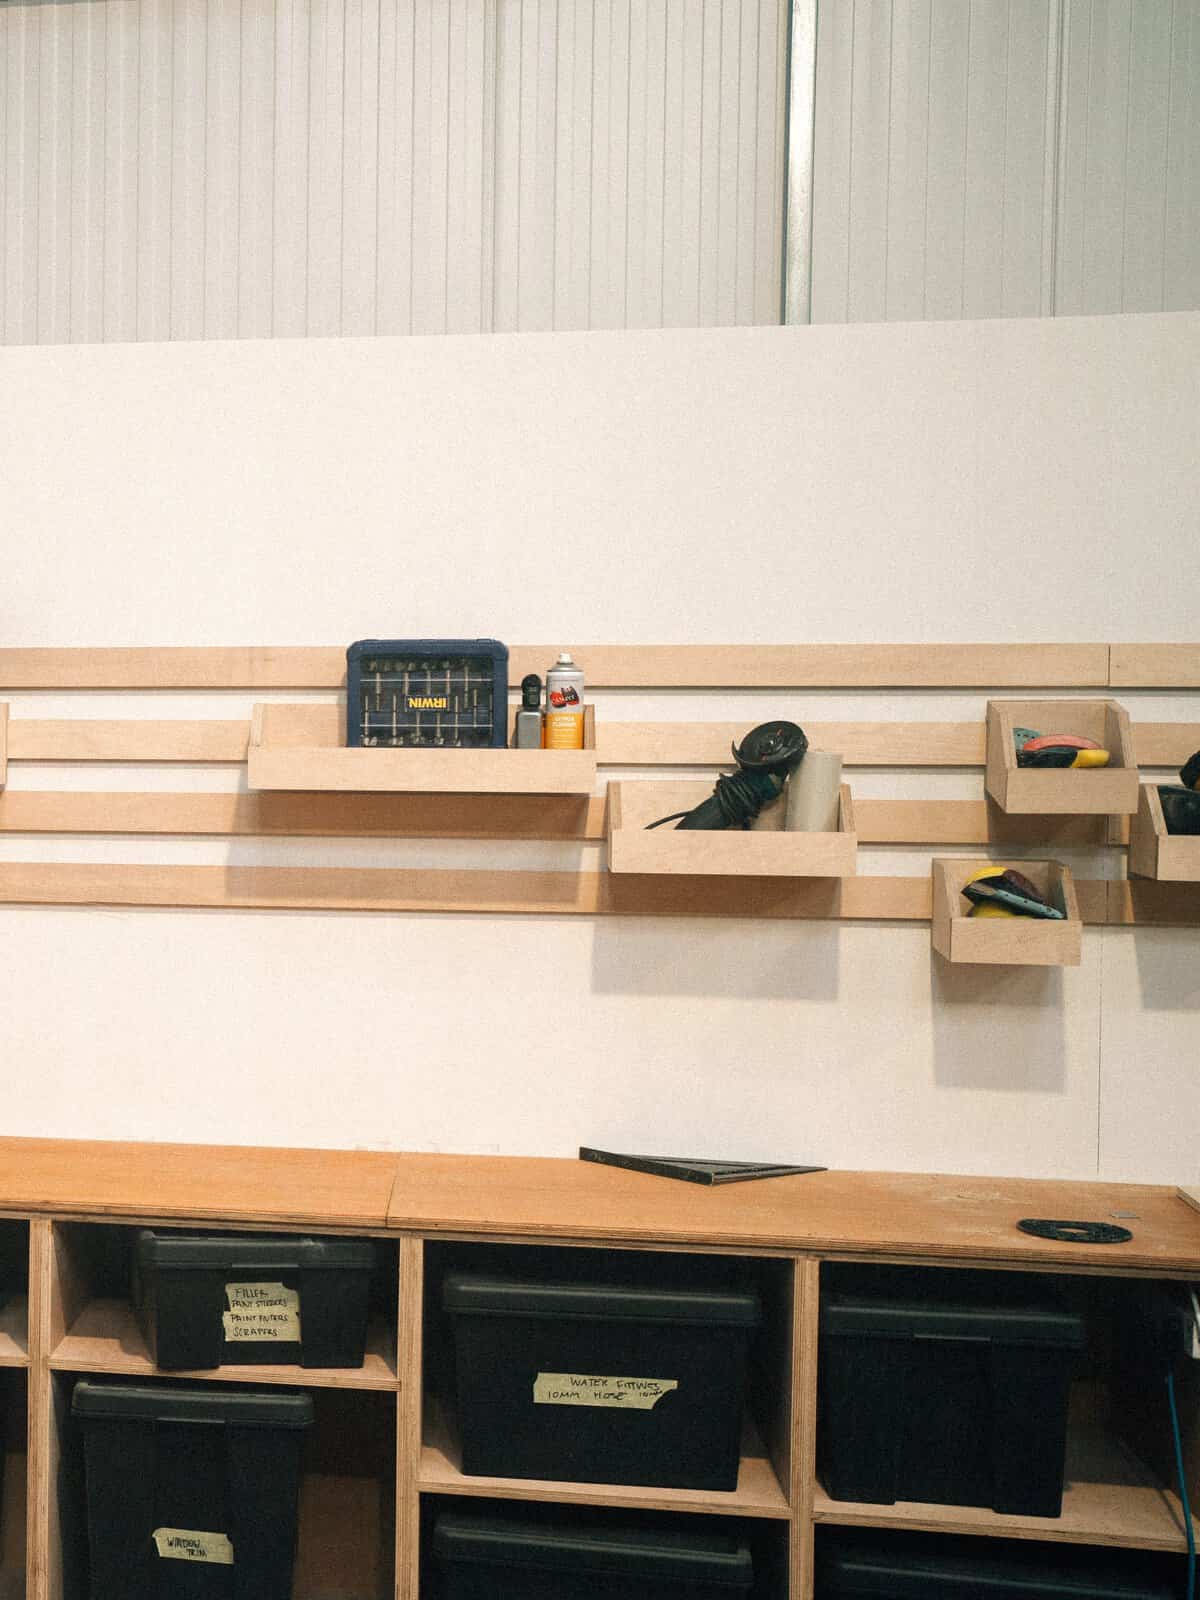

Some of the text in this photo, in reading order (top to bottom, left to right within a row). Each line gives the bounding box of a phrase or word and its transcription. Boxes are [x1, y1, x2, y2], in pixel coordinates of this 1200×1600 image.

[408, 697, 447, 708] IRWIN
[231, 1314, 256, 1323] PAINT
[569, 1376, 609, 1388] WATER
[548, 1390, 580, 1400] 10MM
[594, 1391, 628, 1401] HOSE
